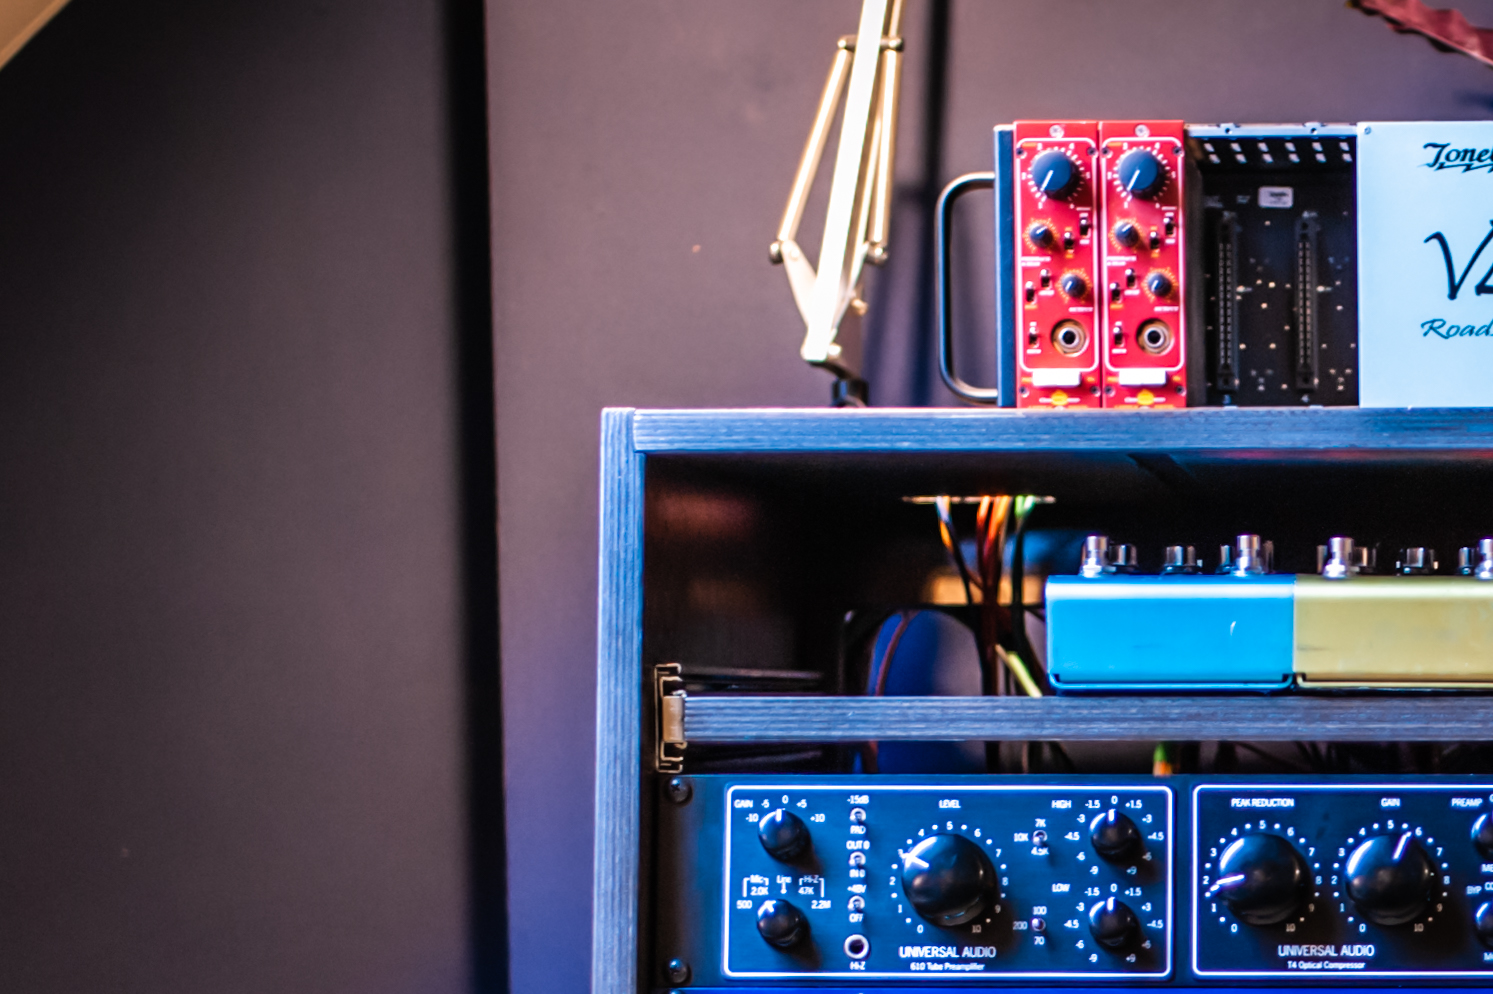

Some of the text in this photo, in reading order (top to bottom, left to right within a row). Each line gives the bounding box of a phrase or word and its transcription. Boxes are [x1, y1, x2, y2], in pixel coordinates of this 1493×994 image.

[734, 799, 753, 808] GAIN
[939, 799, 961, 808] LEVEL
[1051, 800, 1071, 809] HIGH
[1231, 798, 1295, 807] PEAK REDUCTION
[1381, 798, 1400, 807] GAIN
[1451, 798, 1482, 807] PREAMP
[777, 875, 791, 884] Line
[1052, 883, 1070, 892] LOW
[1467, 886, 1482, 895] BYP
[1033, 906, 1047, 915] 100
[1013, 921, 1027, 930] 200
[1034, 936, 1045, 945] 70
[899, 946, 996, 958] UNIVERSAL AUDIO
[1278, 945, 1375, 957] UNIVERSAL AUDIO
[910, 962, 985, 971] 610 Tube Preamplifier
[1287, 961, 1366, 971] T4 Optical Compressor
